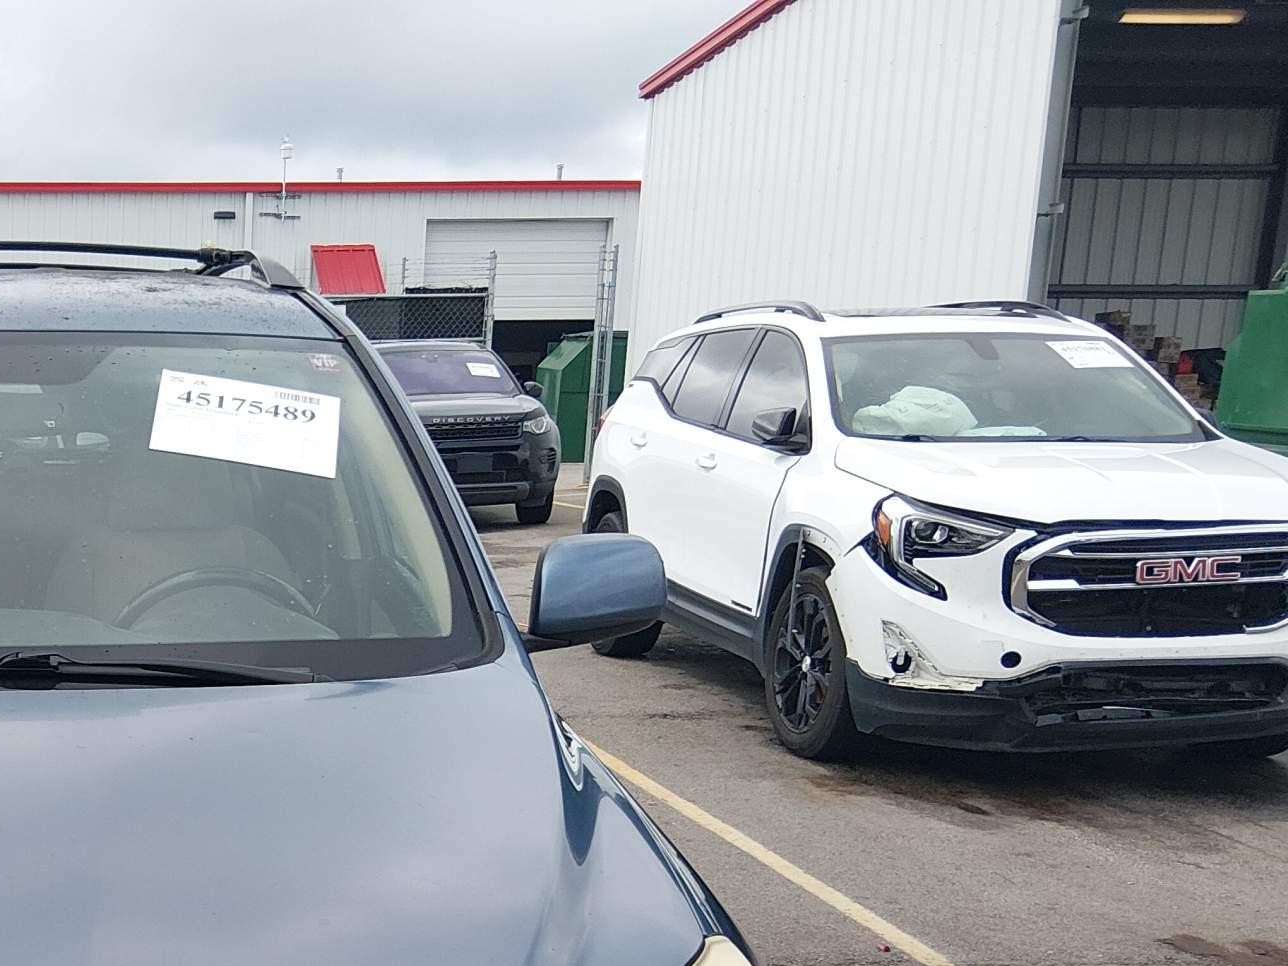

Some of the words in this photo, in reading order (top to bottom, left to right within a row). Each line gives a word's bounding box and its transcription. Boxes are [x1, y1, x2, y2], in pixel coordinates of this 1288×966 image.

[176, 389, 317, 424] 45175489
[432, 415, 511, 424] DISCOVERY
[1135, 555, 1242, 584] GMC
